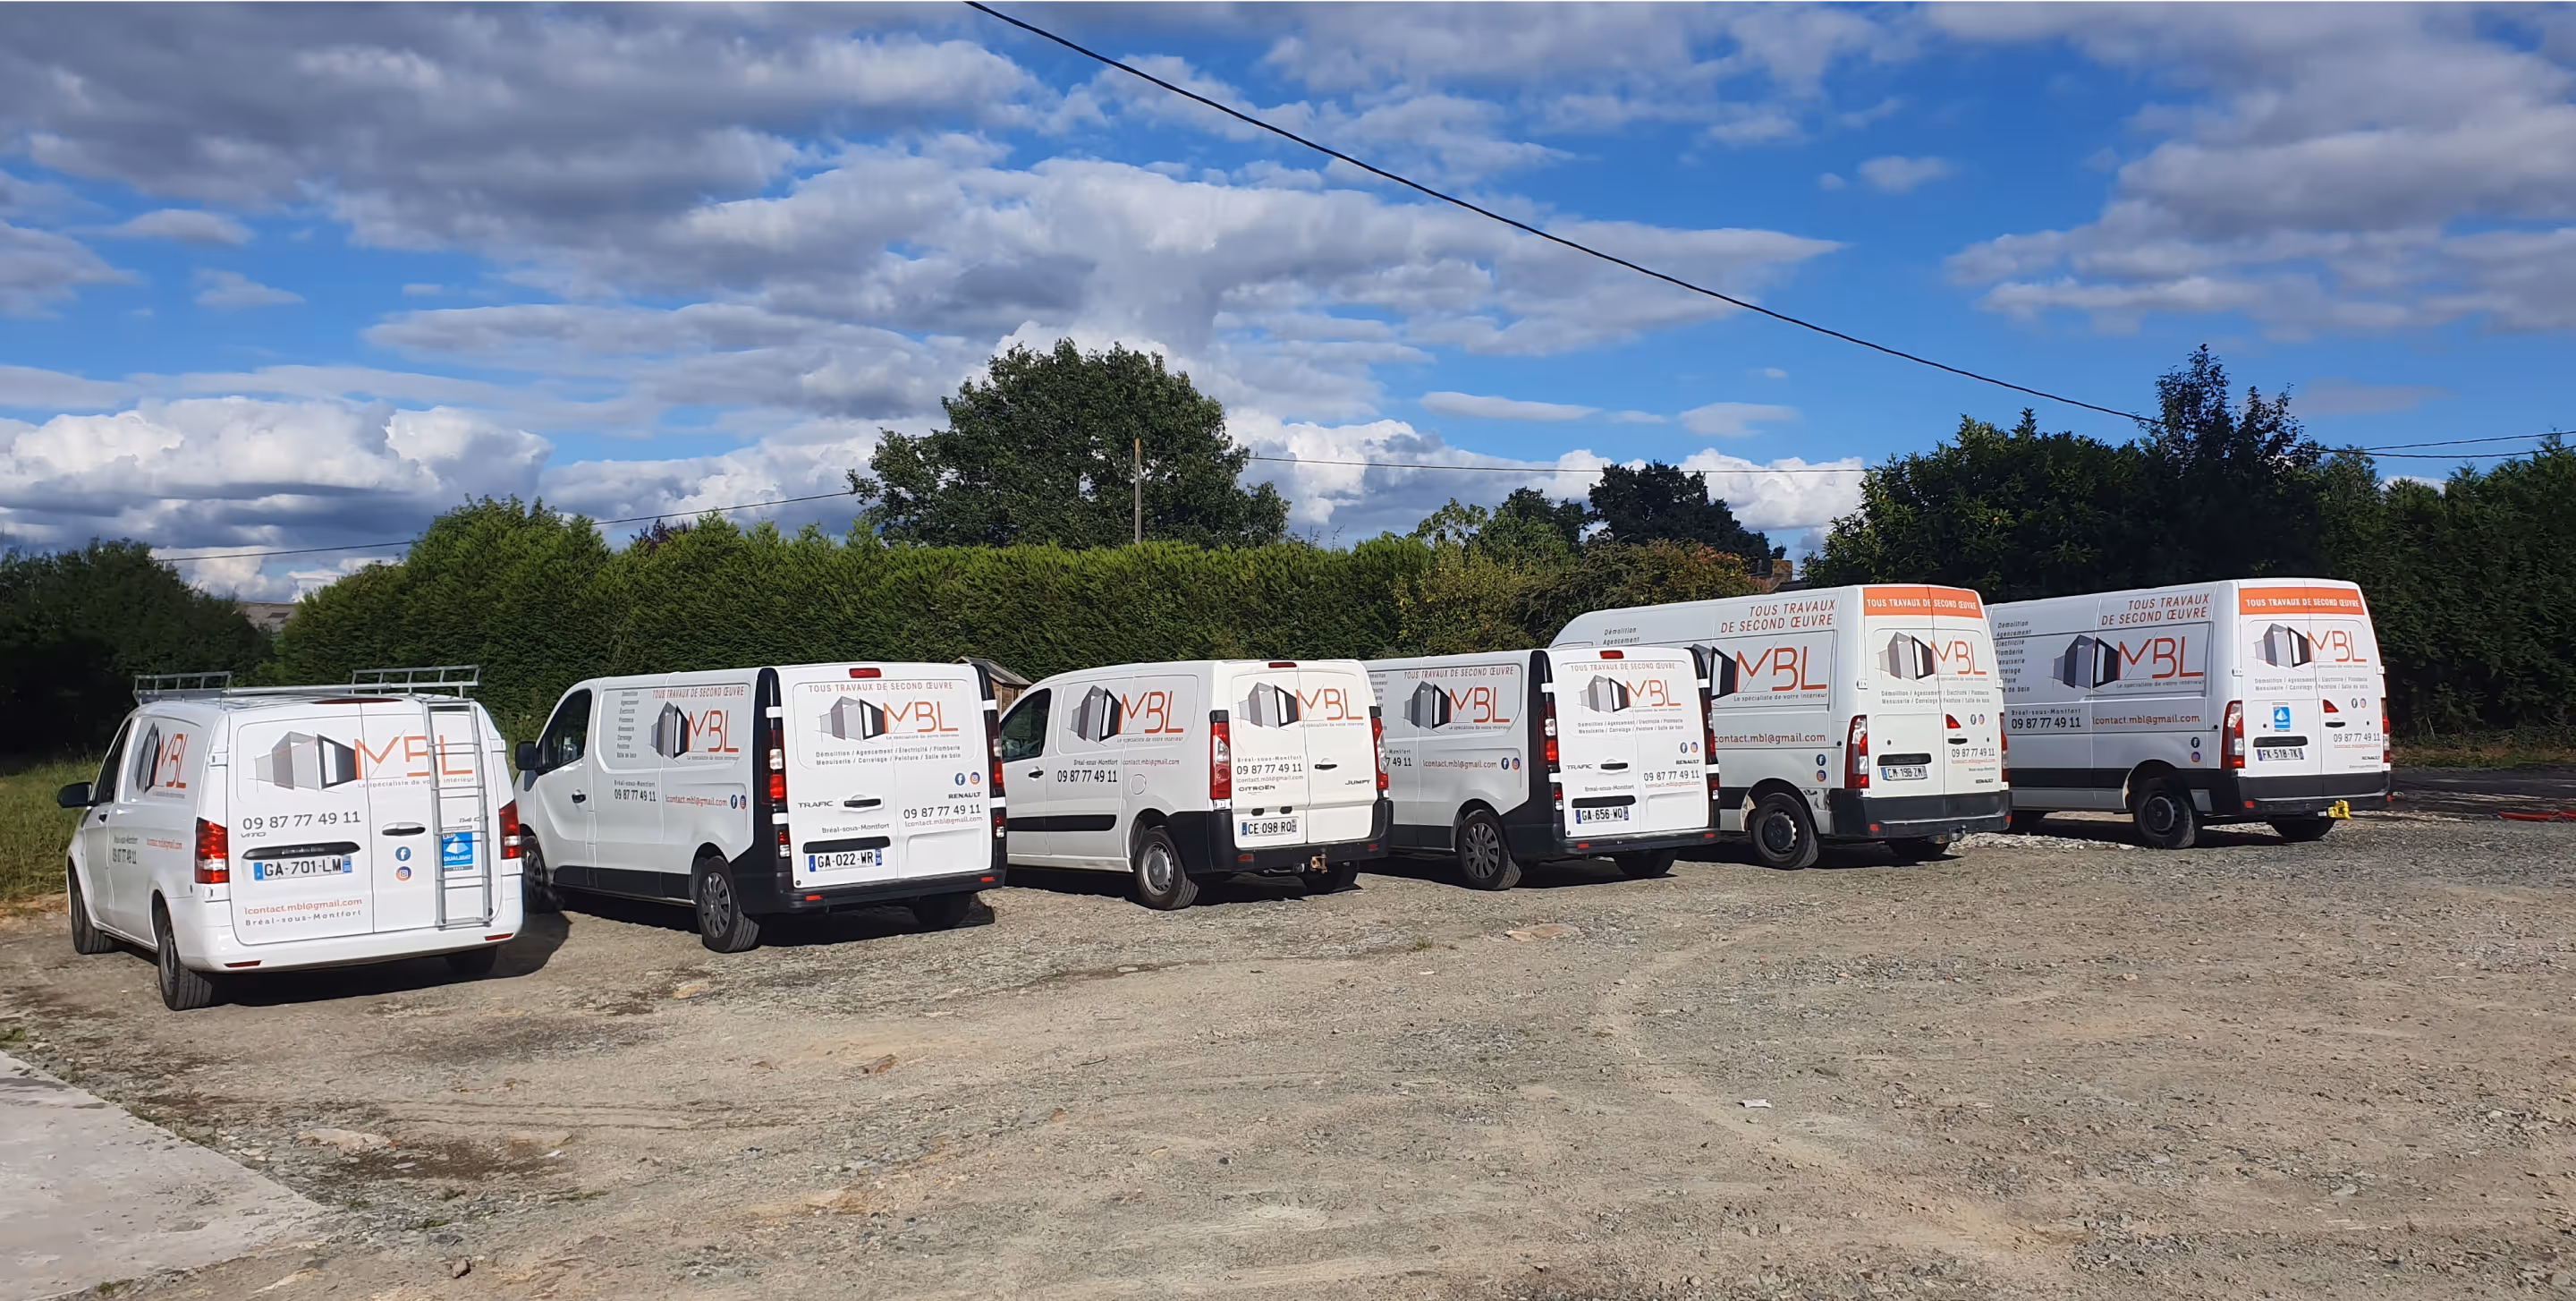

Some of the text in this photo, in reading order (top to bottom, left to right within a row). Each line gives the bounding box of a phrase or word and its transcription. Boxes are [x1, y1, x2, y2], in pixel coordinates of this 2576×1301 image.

[1750, 599, 1835, 616] TOUS TRAVAUX
[1868, 599, 1886, 608] TOUS
[1934, 600, 1957, 608] SECOND
[1959, 601, 1977, 609] ŒUVRE
[2129, 593, 2208, 610] TOUS TRAVAUX
[1721, 614, 1833, 633] DE SECOND ŒUVRE
[2102, 607, 2207, 625] DE SECOND ŒUVRE
[1605, 626, 1636, 635] Démolition
[1998, 620, 2029, 628] Démolition
[1603, 636, 1640, 646] Agencement
[2307, 631, 2367, 662] MBL
[1930, 641, 1987, 675] MBL
[2117, 636, 2204, 680] MBL
[1422, 669, 1448, 678] TRAVAUX
[1450, 668, 1458, 677] DE
[1461, 668, 1487, 676] SECOND
[1490, 667, 1513, 676] ŒUVRE
[1734, 646, 1826, 693] MBL
[653, 686, 743, 699] TOUS TRAVAUX DE SECOND ŒUVRE
[809, 685, 831, 693] TOUS
[927, 682, 953, 690] ŒUVRE
[1626, 680, 1681, 707] MBL
[1296, 688, 1363, 721] MBL
[1449, 687, 1510, 723] MBL
[884, 702, 958, 734] MBL
[1117, 691, 1183, 735] MBL
[2012, 717, 2080, 728] 09 87 77 49 11
[687, 710, 739, 753] MBL
[2334, 733, 2380, 742] 09 87 77 49 11
[354, 735, 472, 780] MBL
[1952, 748, 1995, 757] 09 87 77 49 11
[1237, 763, 1302, 774] 09 87 77 49 11
[1393, 758, 1411, 767] 49 11
[1057, 770, 1117, 782] 09 87 77 49 11
[1644, 772, 1654, 781] 09
[1657, 772, 1665, 781] 87
[1668, 771, 1677, 780] 77
[1680, 770, 1688, 778] 49
[614, 789, 657, 802] 09 87 77 49 11
[903, 804, 980, 819] 09 87 77 49 11
[242, 812, 360, 830] 09 87 77 49 11
[822, 823, 889, 834] Bréal-sous-Montfort
[265, 859, 342, 876] GA-701-LM
[818, 852, 873, 868] GA-022-WR
[246, 910, 360, 925] Bréal-sous-Montfort
